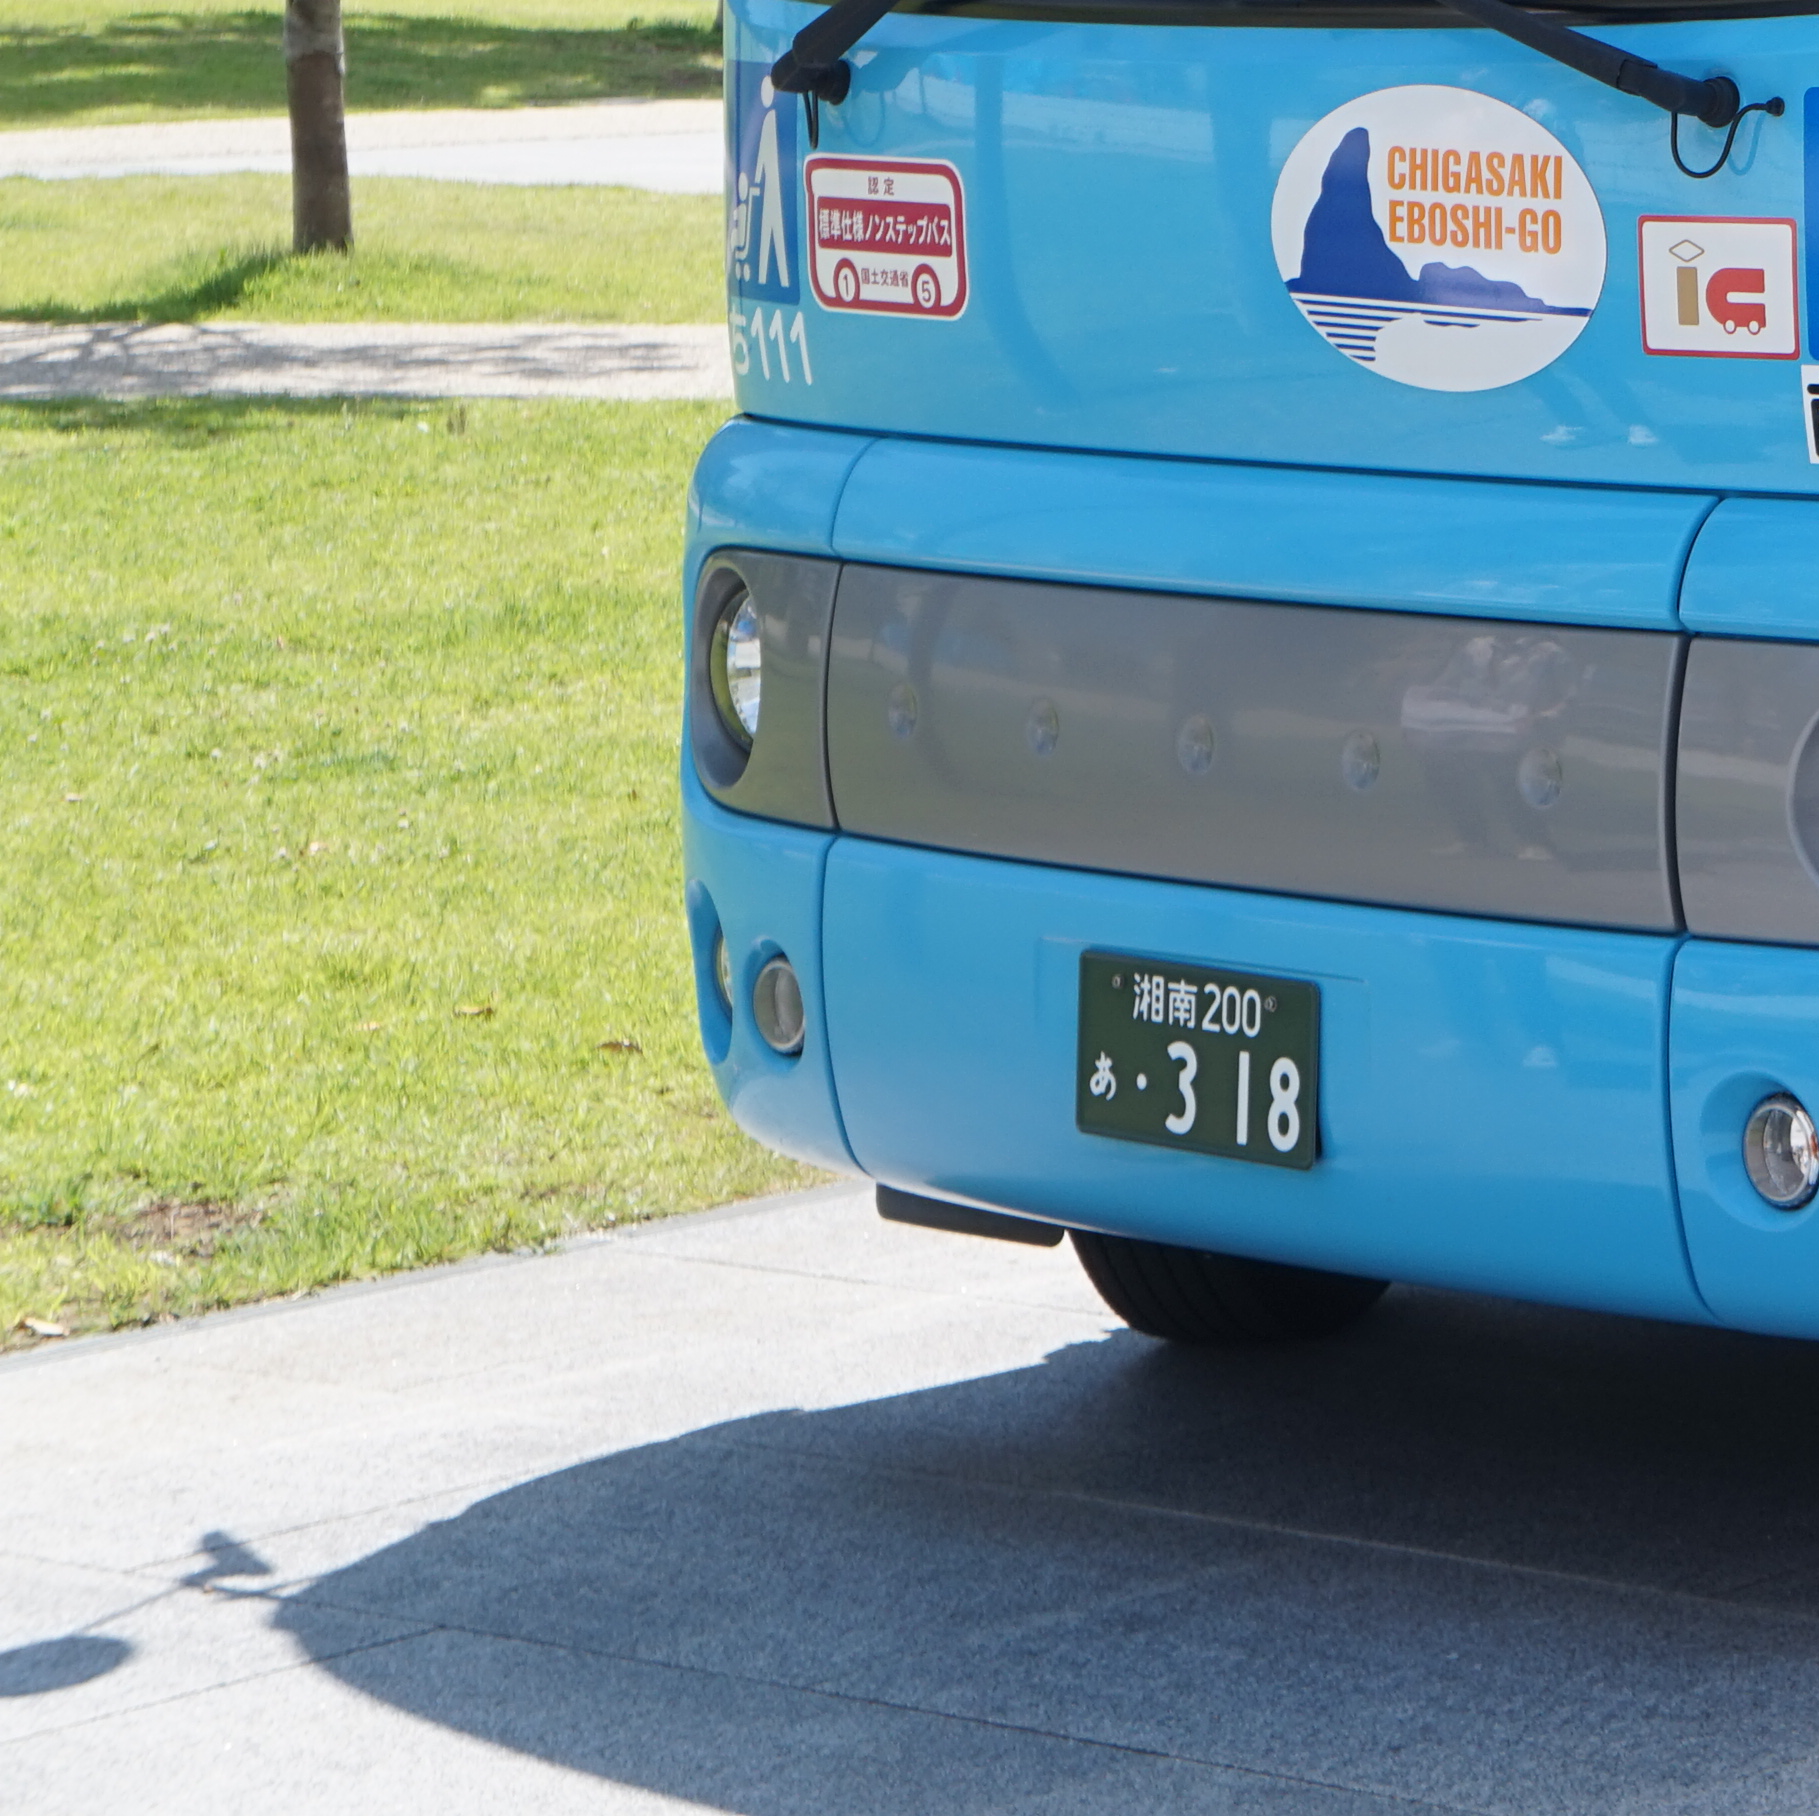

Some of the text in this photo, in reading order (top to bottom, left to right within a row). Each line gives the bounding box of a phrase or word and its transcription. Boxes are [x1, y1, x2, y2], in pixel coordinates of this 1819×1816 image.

[1387, 145, 1564, 201] CHIGASAKI
[818, 208, 951, 246] 標準仕様ノンステップバス
[1388, 198, 1563, 255] EBOSHI-GO
[860, 267, 909, 289] 国土交通省
[1089, 1050, 1117, 1101] あ
